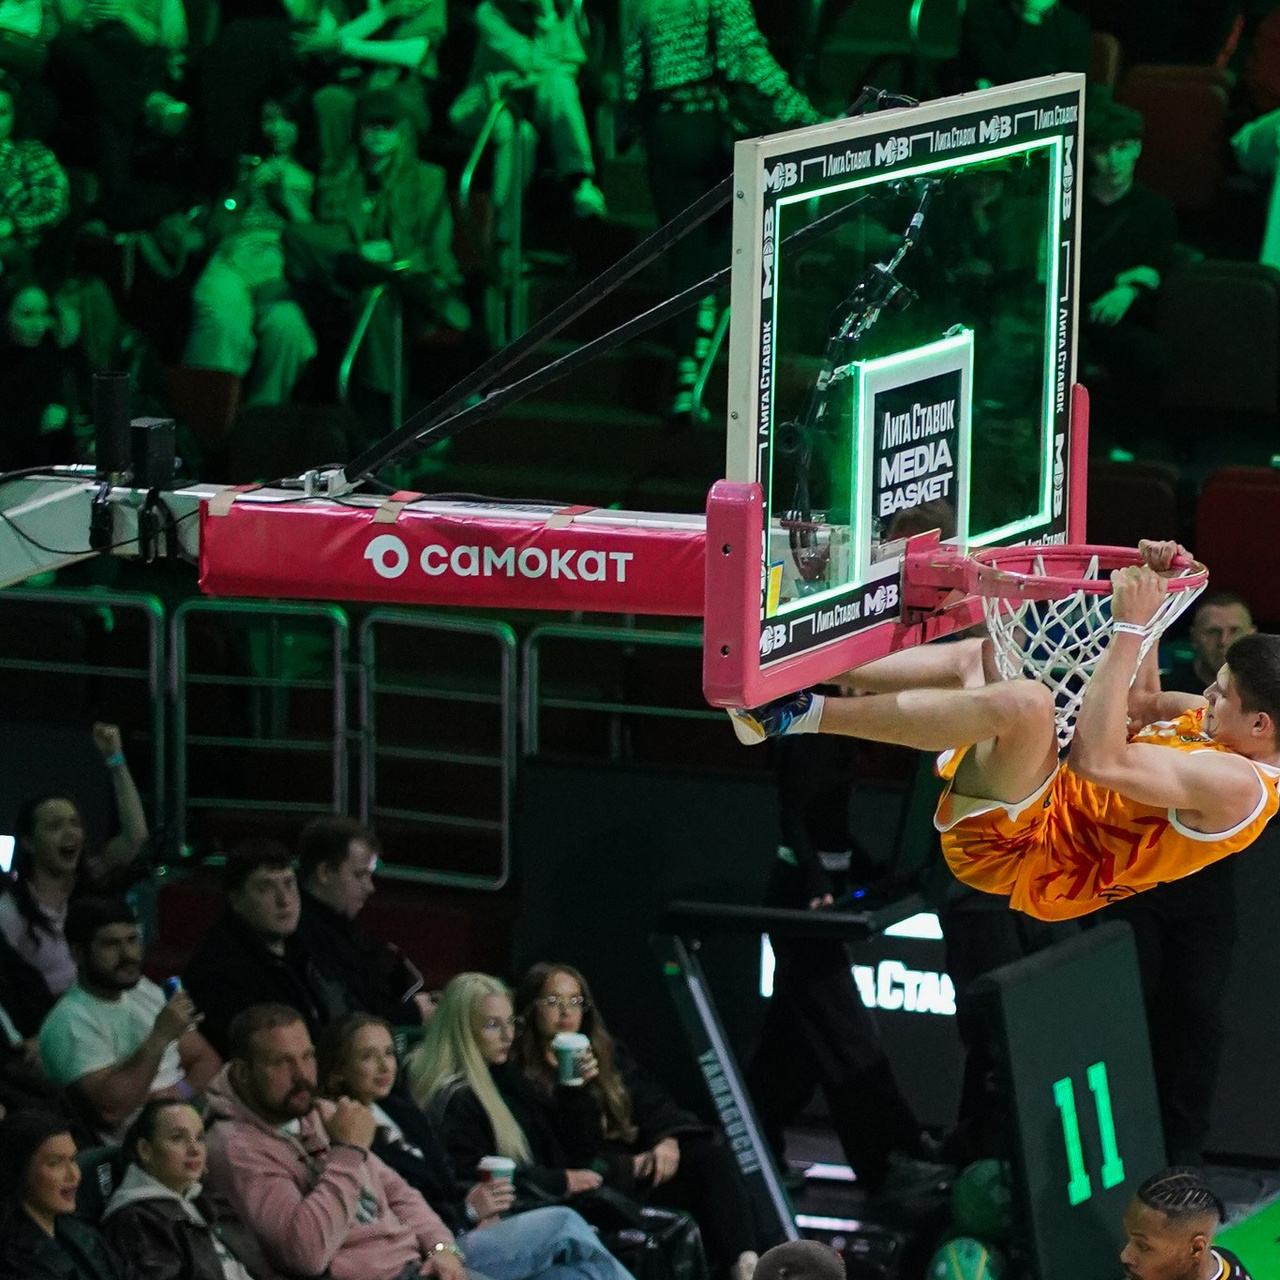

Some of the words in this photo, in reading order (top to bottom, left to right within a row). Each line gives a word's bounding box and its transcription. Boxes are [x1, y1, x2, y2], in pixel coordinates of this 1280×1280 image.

[880, 438, 953, 489] MEDIA
[880, 471, 953, 518] BASKET
[1052, 1060, 1126, 1207] 11
